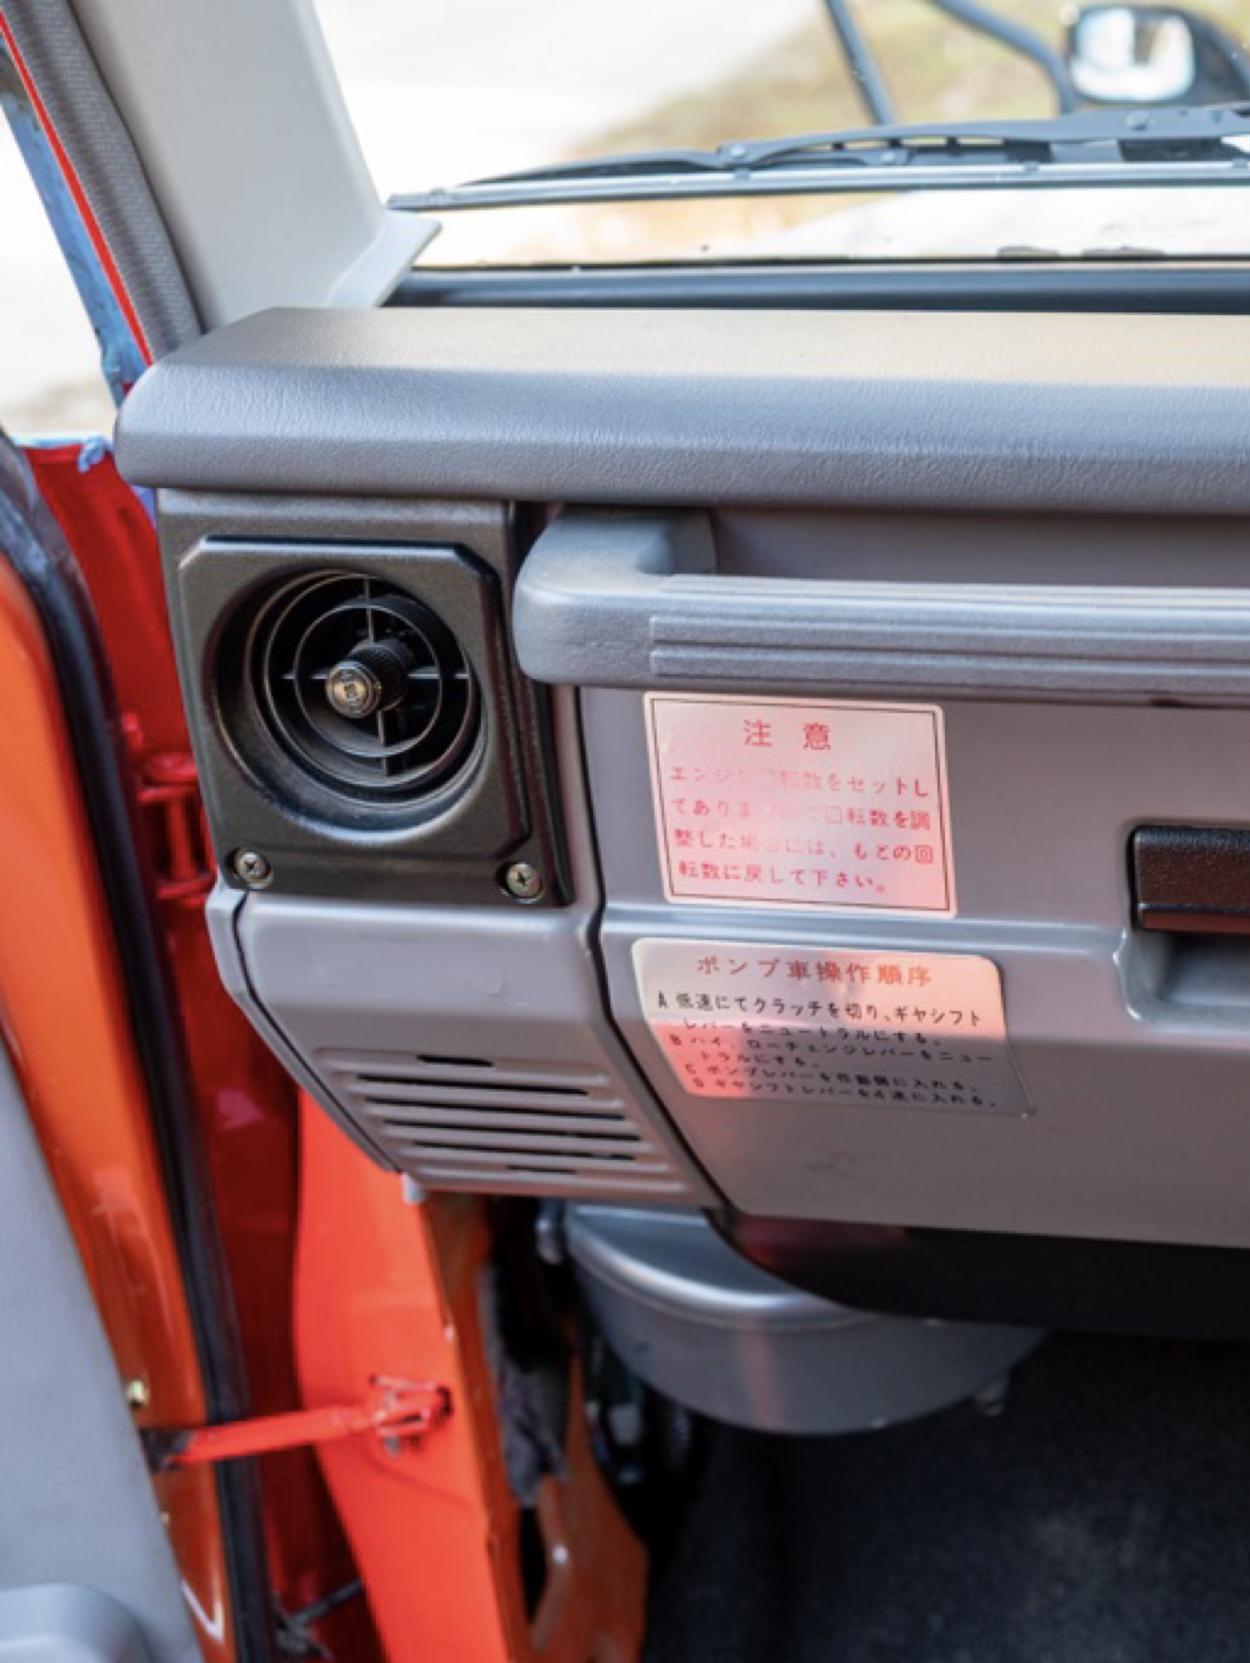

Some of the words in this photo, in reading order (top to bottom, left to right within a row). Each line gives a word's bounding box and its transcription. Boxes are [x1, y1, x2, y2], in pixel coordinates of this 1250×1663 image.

[697, 955, 933, 987] ポンプ車操作順序
